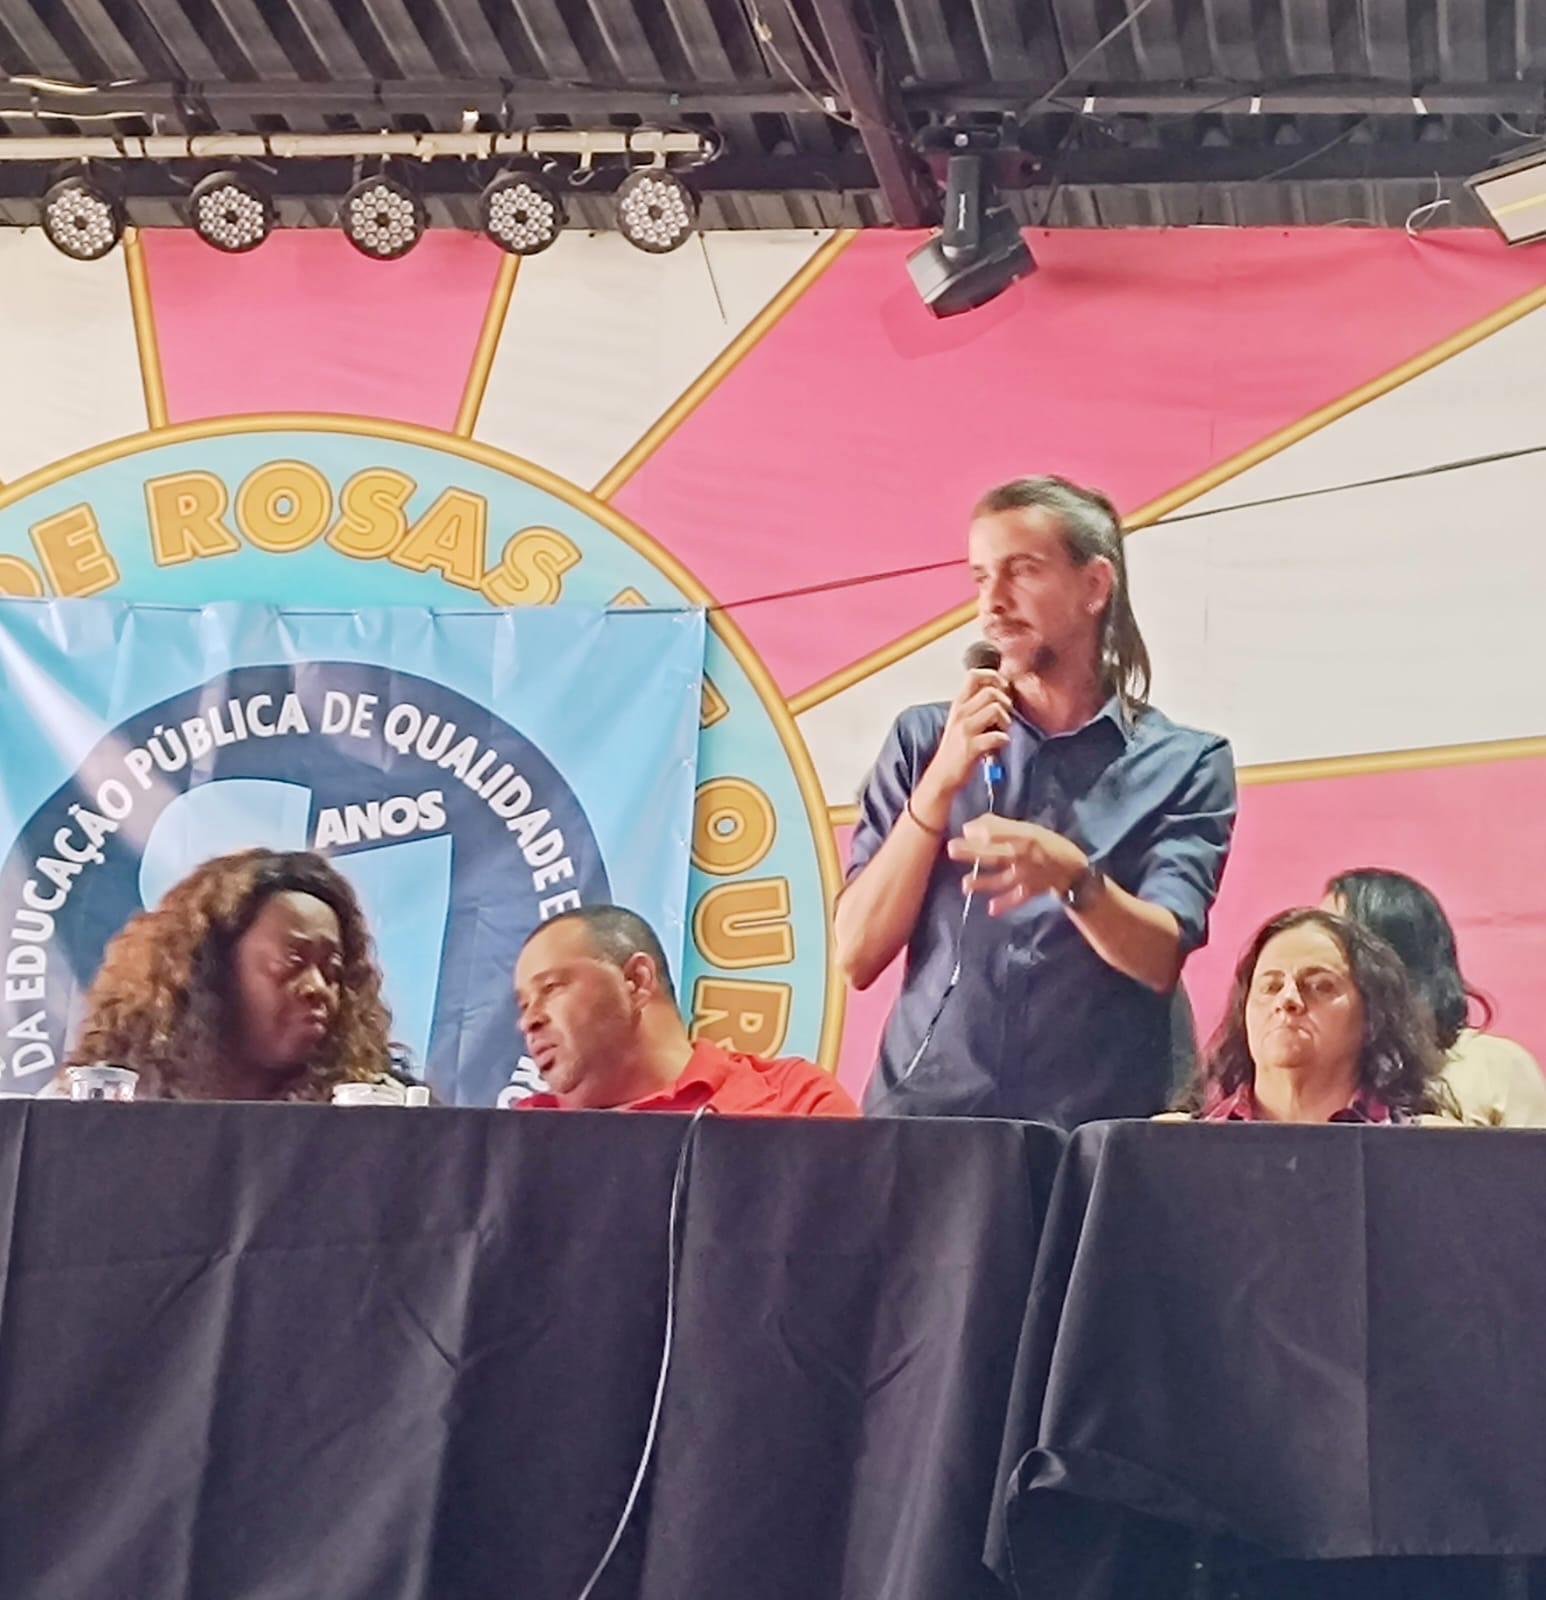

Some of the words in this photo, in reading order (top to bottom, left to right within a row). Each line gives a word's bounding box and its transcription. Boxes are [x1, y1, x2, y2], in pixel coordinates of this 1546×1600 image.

[143, 459, 582, 605] ROSAS
[124, 693, 310, 789] PÚBLICA
[321, 690, 378, 738] DE
[314, 791, 446, 848] ANOS
[383, 703, 575, 892] QUALIDADE
[5, 780, 134, 1001] EDUCAÇÃO
[7, 1010, 55, 1077] DA
